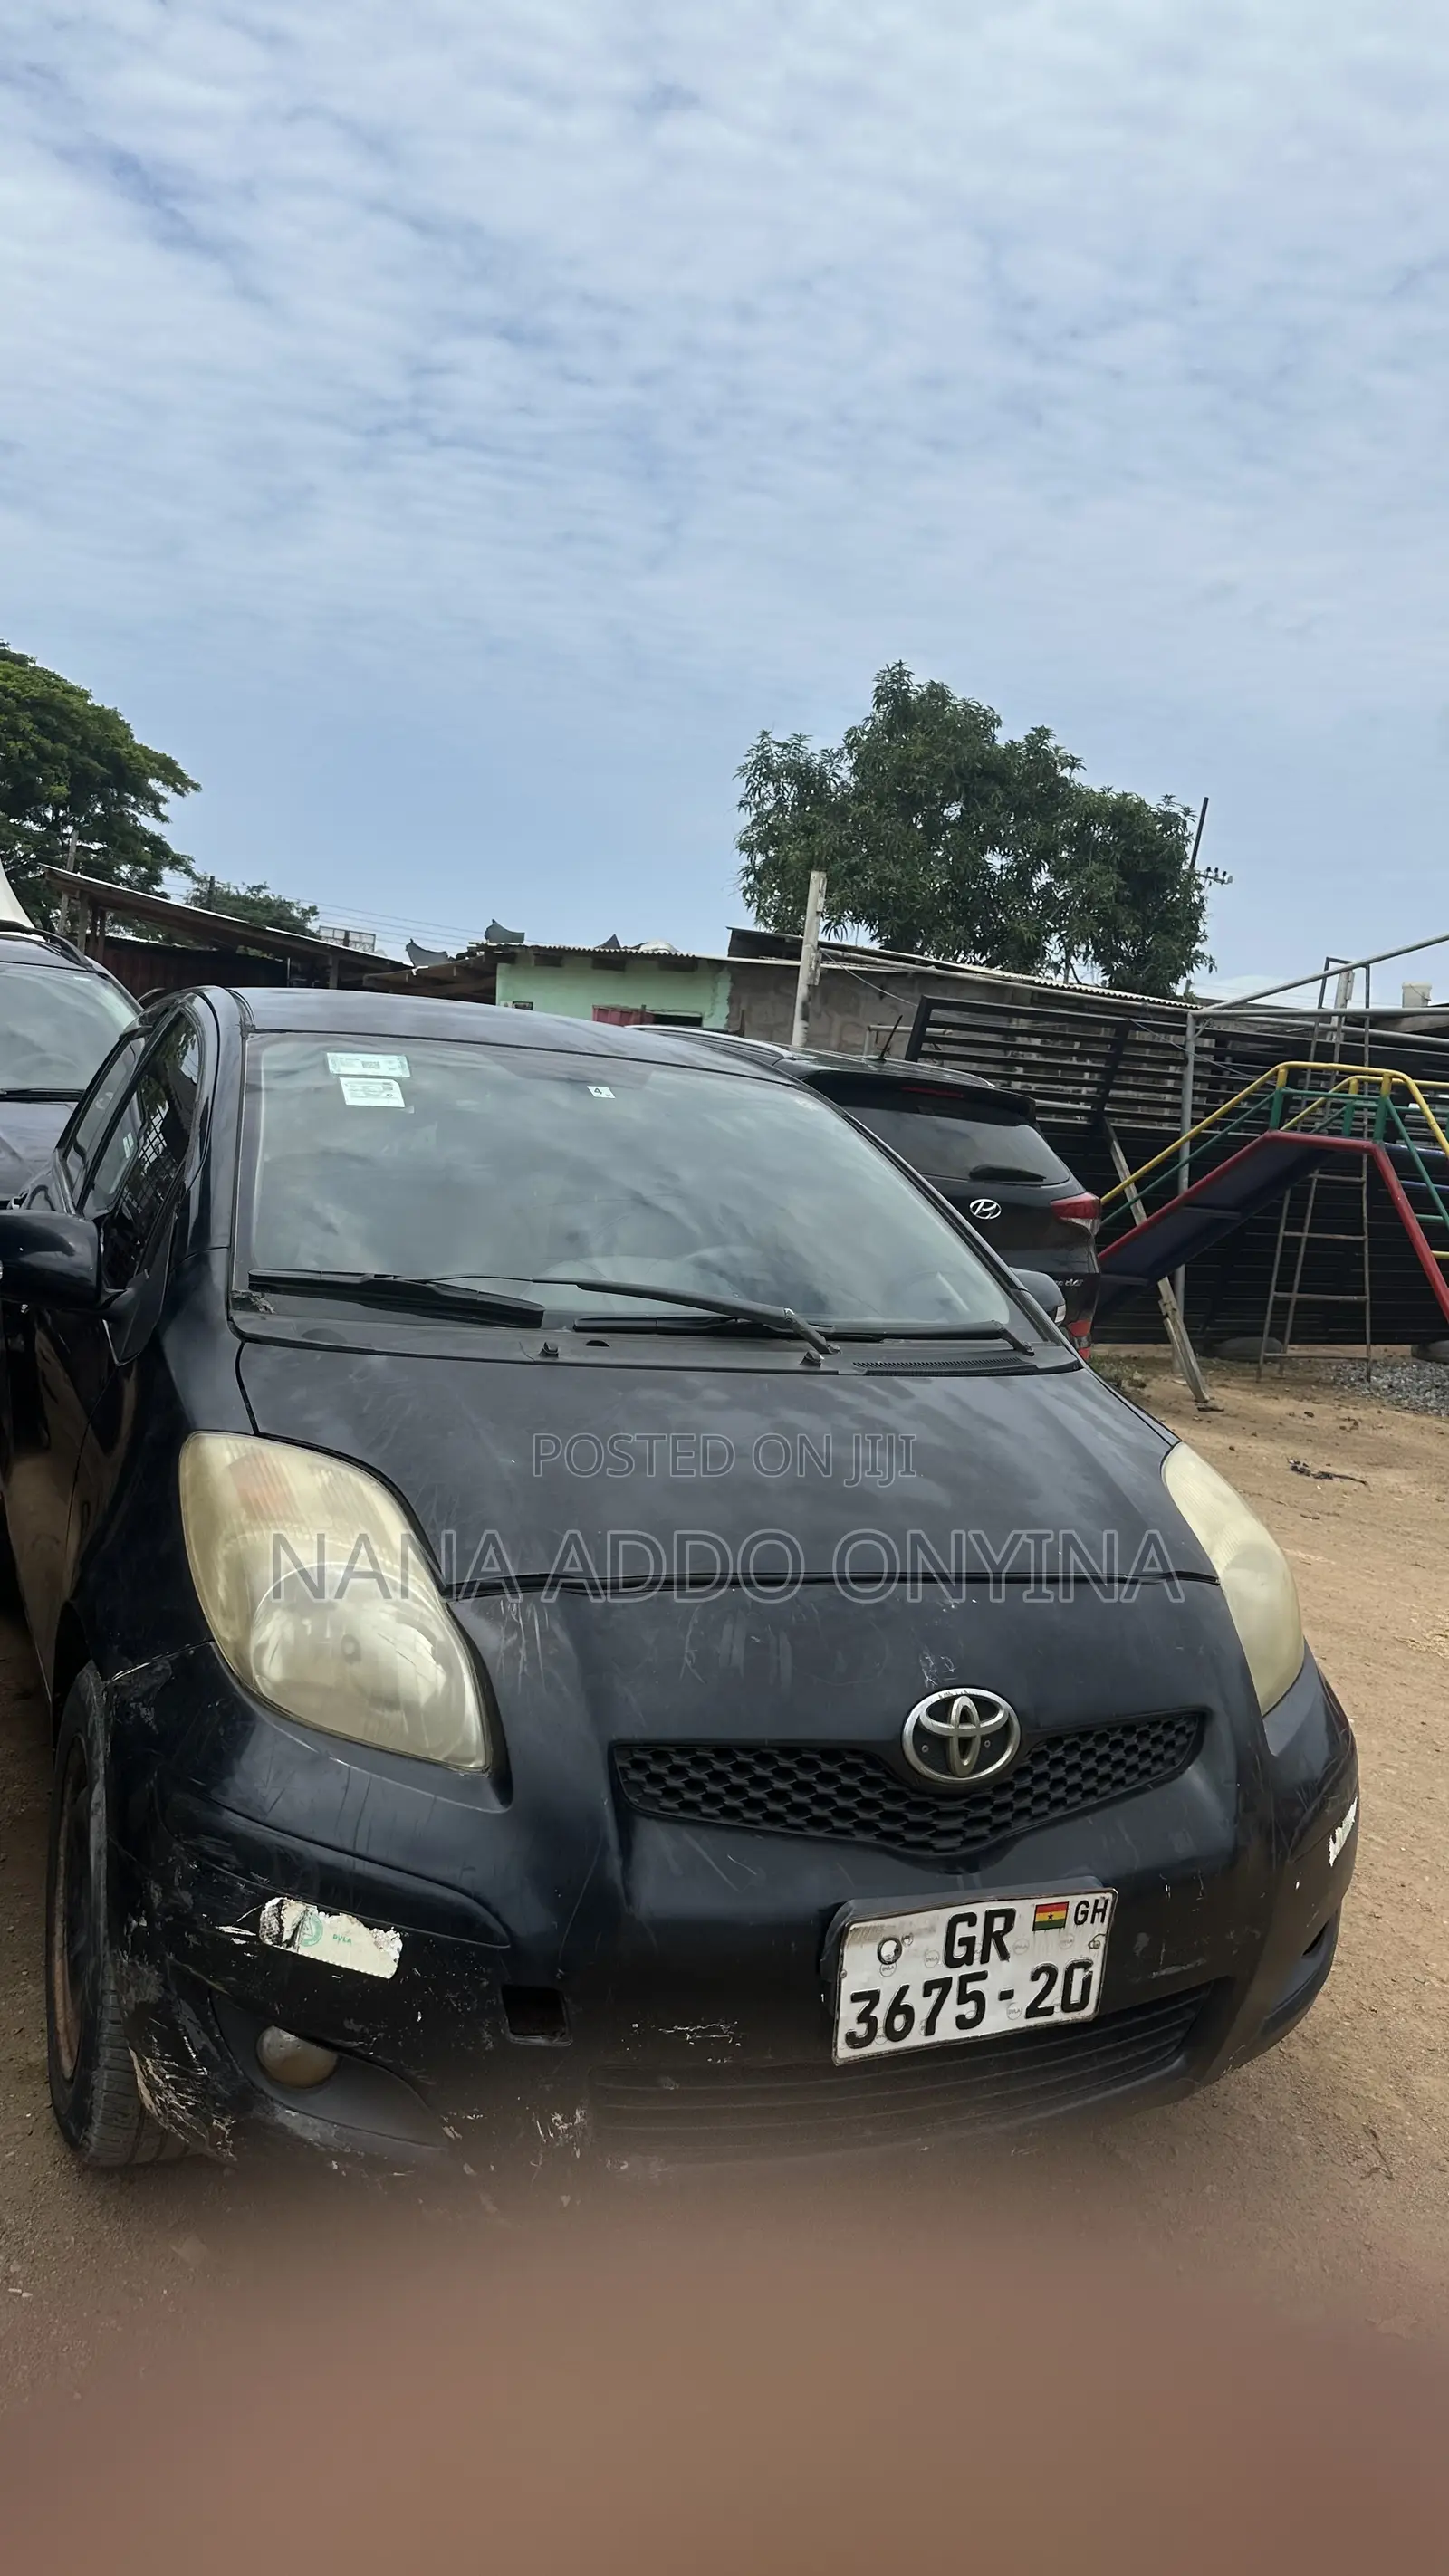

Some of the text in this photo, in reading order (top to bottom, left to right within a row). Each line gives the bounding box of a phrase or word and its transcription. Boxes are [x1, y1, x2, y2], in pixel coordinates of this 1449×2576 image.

[944, 1898, 1109, 1968] GR GH
[845, 1957, 1094, 2049] 3675-20
